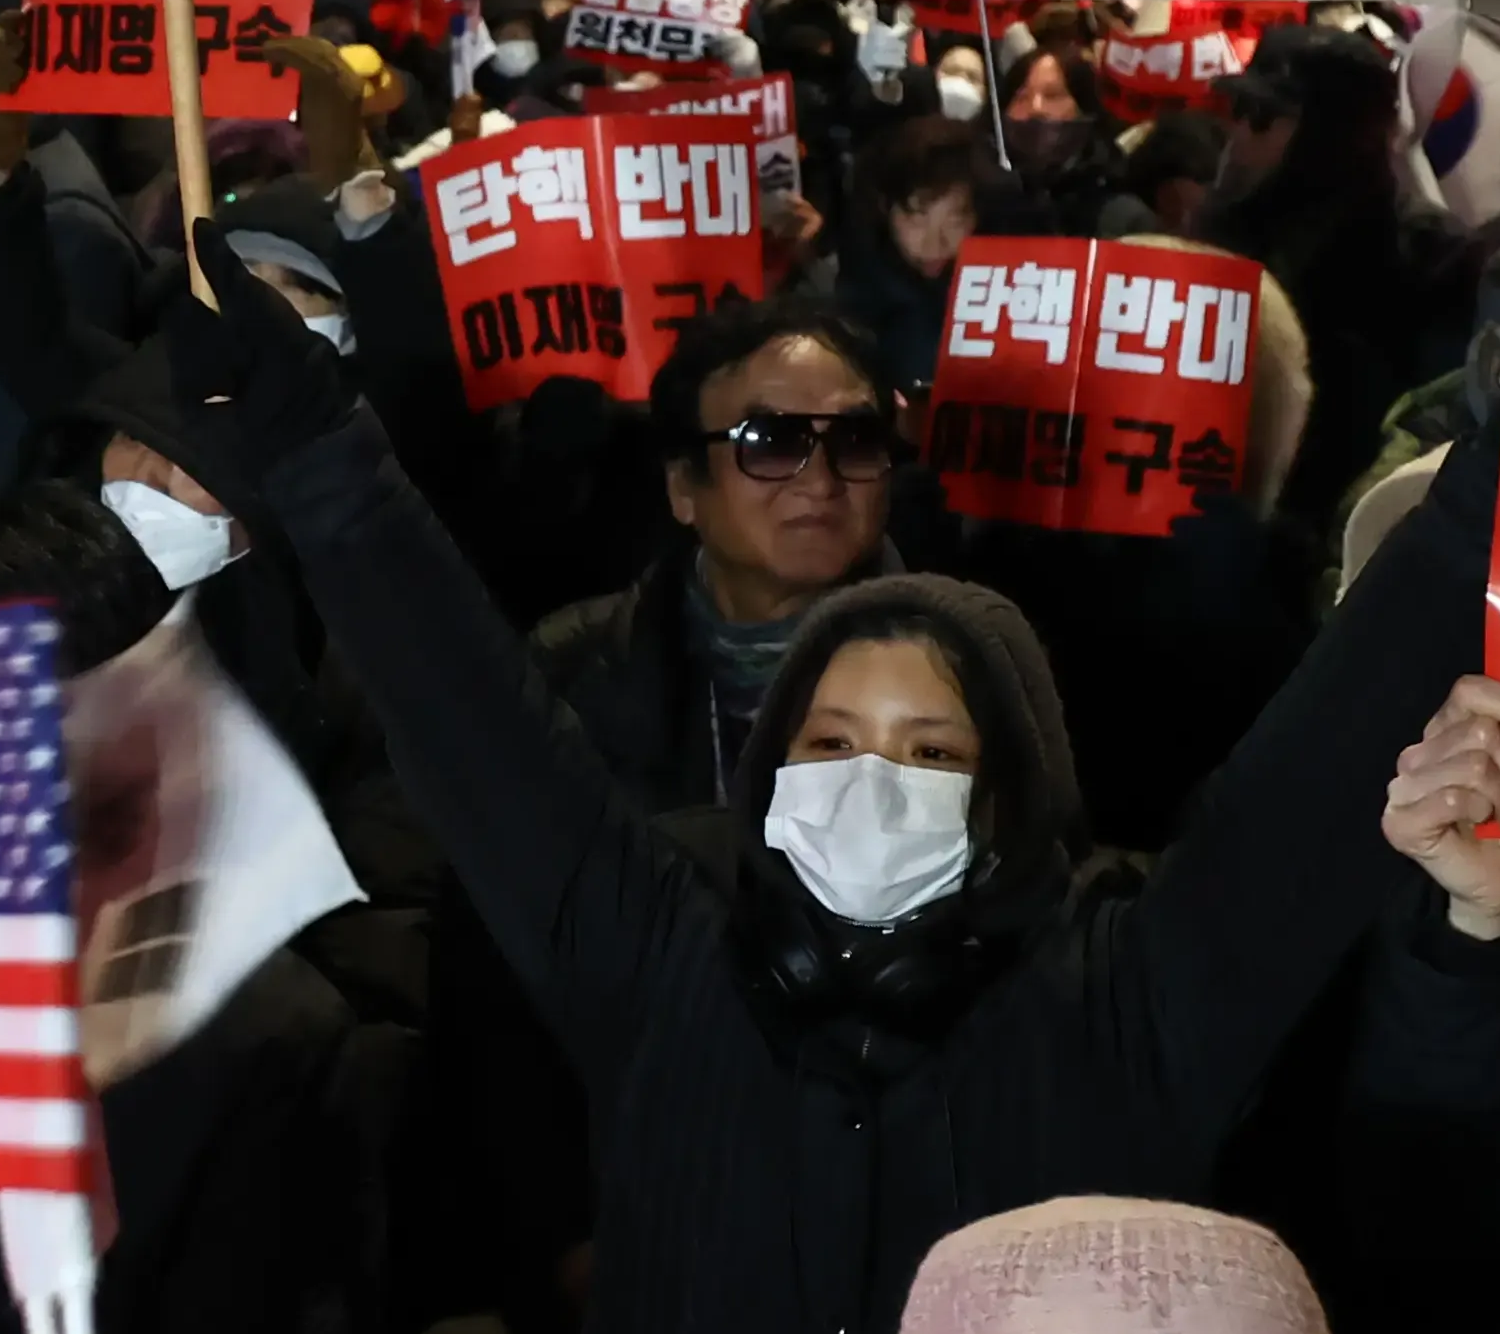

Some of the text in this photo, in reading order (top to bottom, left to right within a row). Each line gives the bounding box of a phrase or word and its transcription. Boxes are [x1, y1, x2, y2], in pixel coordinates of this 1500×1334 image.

[574, 9, 718, 63] 원천무
[436, 142, 754, 267] 탄핵 반대
[462, 283, 628, 371] 이재명
[947, 260, 1253, 387] 탄핵 반대
[930, 402, 1241, 497] 이재명 구속
